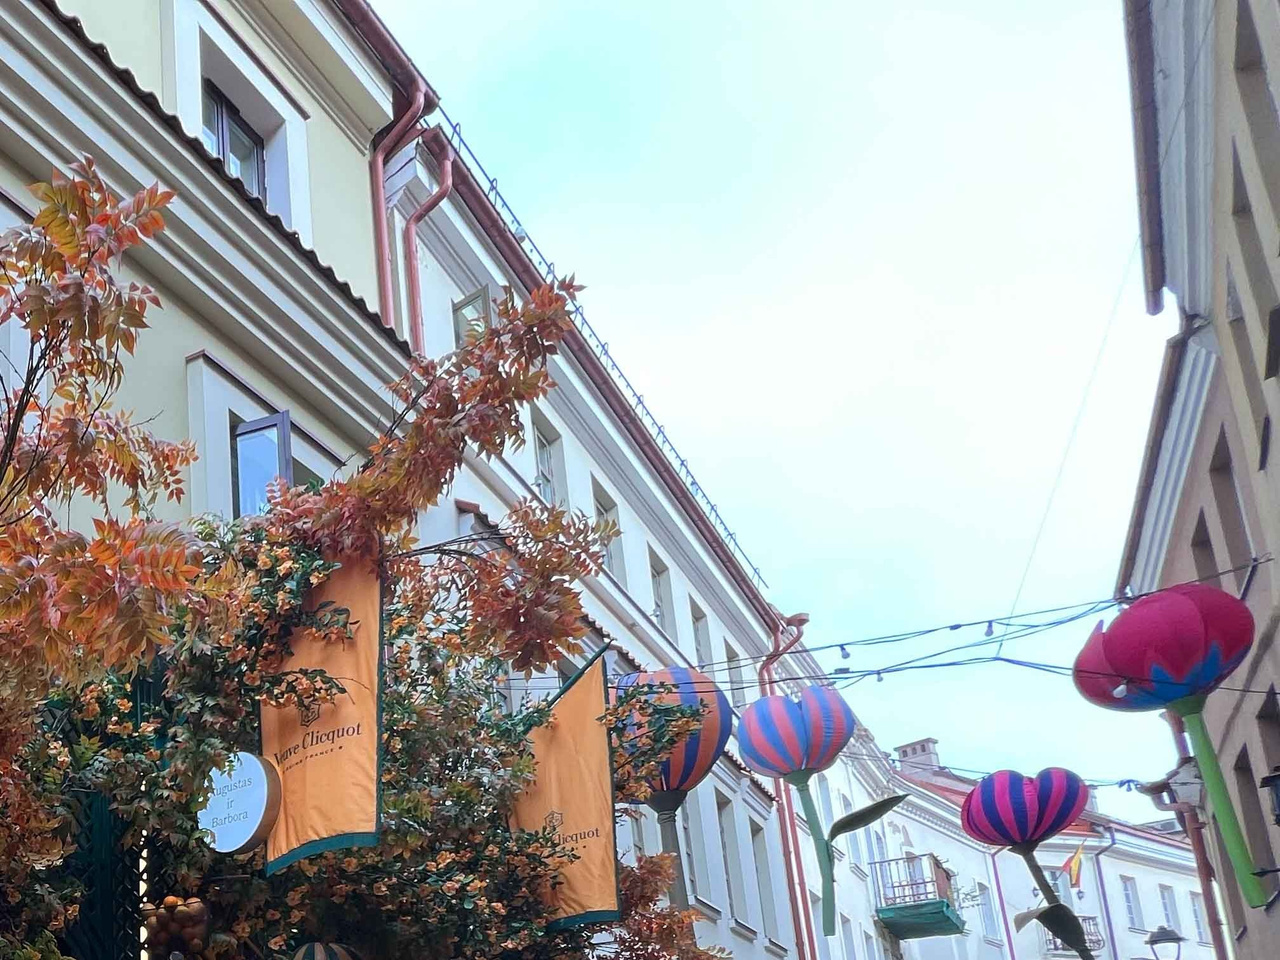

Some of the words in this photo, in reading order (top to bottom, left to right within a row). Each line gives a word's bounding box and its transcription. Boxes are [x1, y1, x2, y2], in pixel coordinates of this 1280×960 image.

[301, 722, 362, 750] Clicquot
[226, 797, 235, 809] ir
[211, 811, 249, 828] Barbora
[558, 827, 600, 846] licquot
